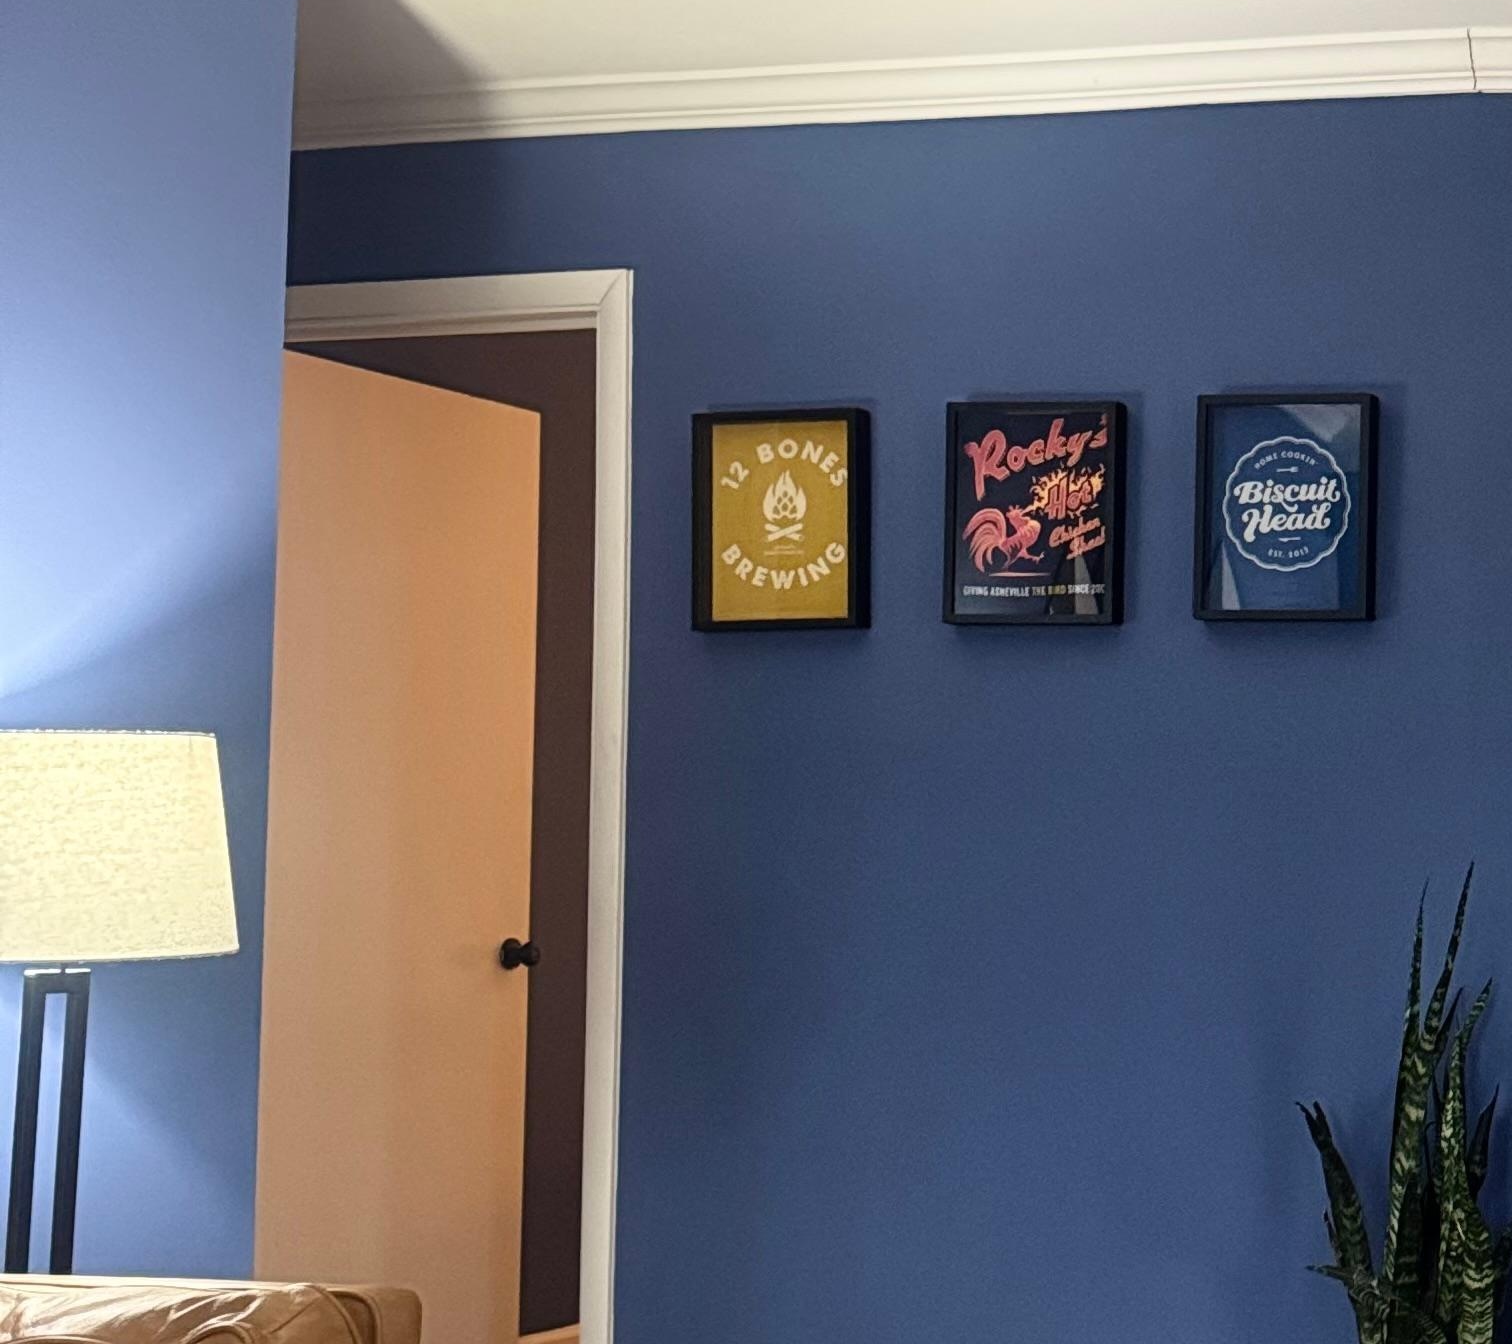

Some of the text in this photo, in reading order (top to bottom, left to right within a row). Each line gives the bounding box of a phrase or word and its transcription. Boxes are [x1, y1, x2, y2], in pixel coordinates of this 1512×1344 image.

[720, 438, 848, 490] 12 BONES
[1253, 452, 1278, 470] HOME
[1045, 476, 1092, 520] Hot
[1233, 476, 1341, 513] Biscuit
[1241, 502, 1332, 543] Head
[721, 542, 846, 590] BREWING
[963, 585, 989, 596] GIVING
[990, 586, 1030, 597] ASHEVILLE
